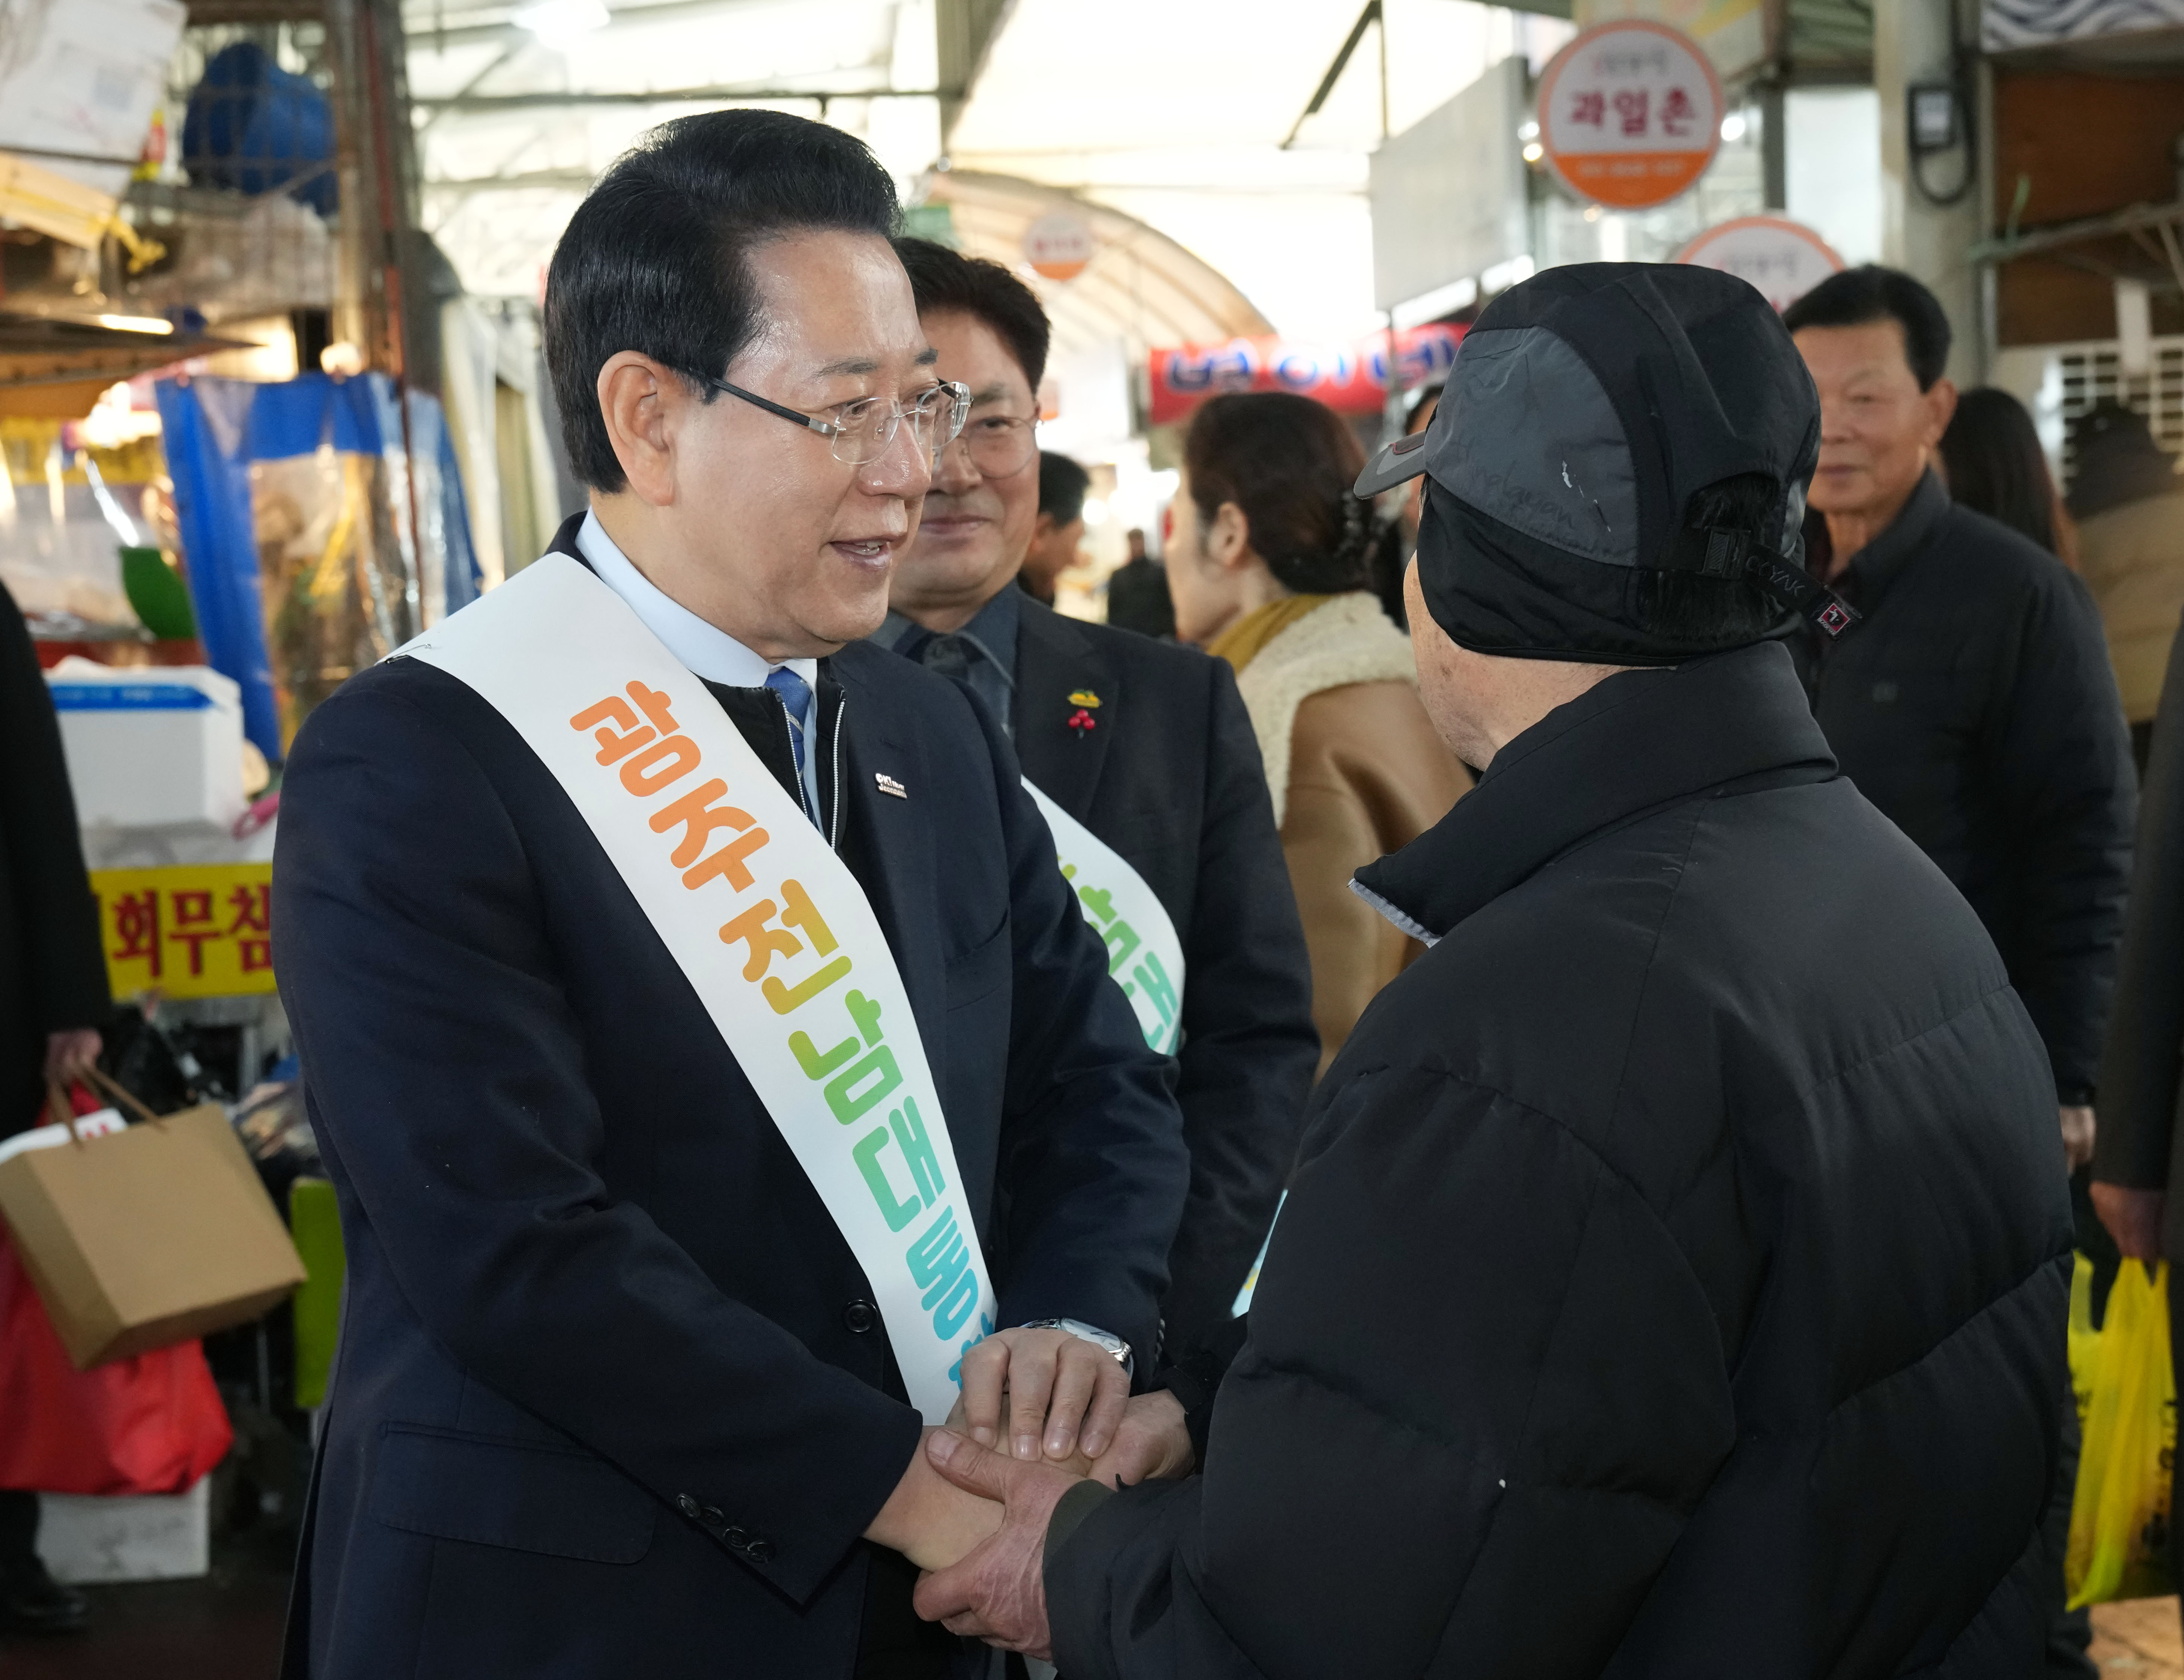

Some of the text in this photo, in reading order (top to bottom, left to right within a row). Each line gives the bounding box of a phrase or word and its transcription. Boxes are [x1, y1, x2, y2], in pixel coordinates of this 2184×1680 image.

[1571, 86, 1695, 137] 과일촌
[95, 884, 273, 977] 회무침
[570, 681, 994, 1392] 광주전남대통
